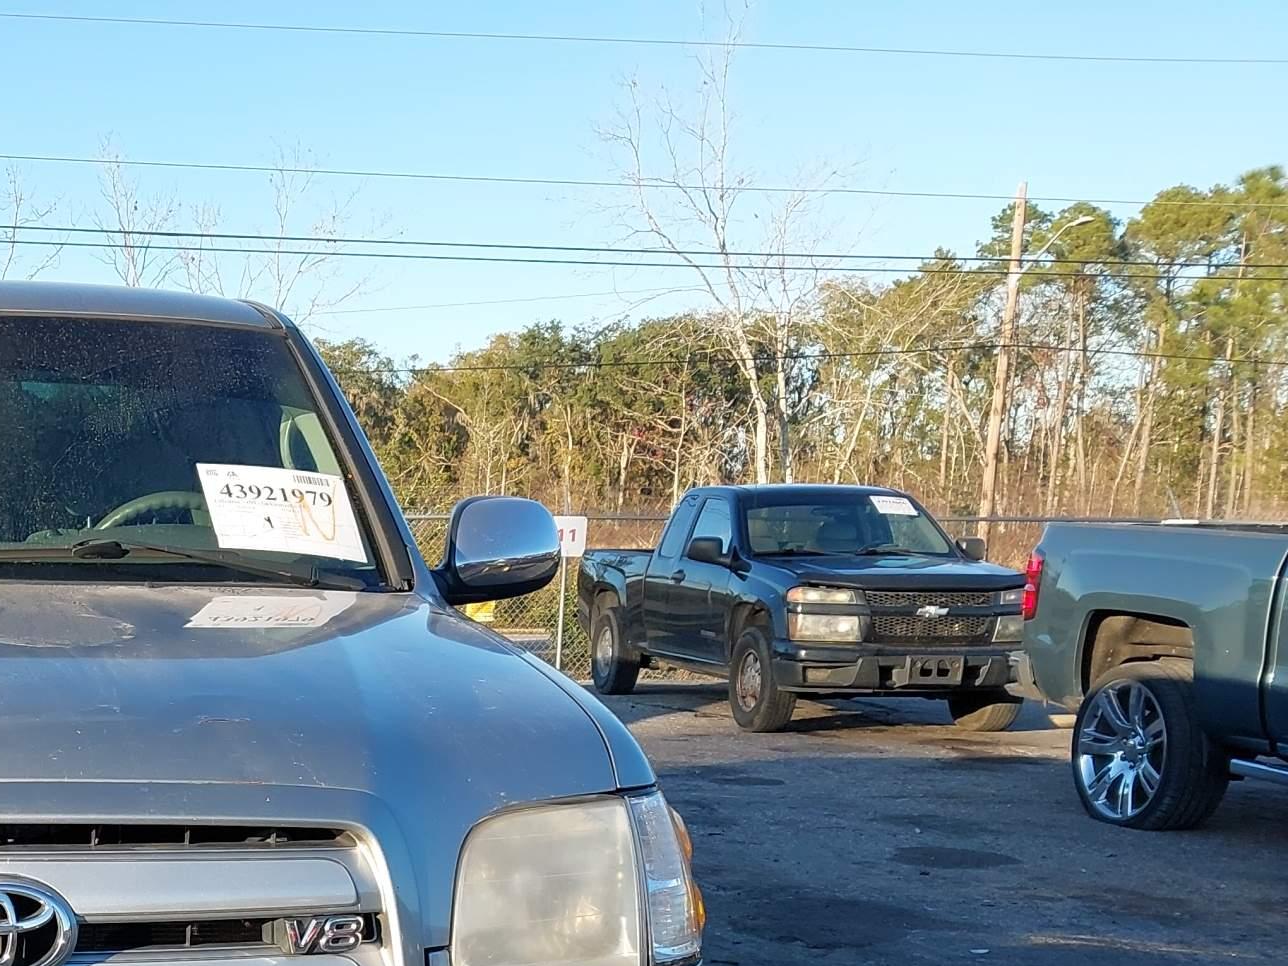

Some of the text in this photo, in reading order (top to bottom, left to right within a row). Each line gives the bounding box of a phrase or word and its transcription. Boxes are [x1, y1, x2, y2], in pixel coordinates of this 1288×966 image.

[219, 483, 333, 507] 43921979
[558, 528, 577, 542] 11
[285, 916, 364, 955] V8
